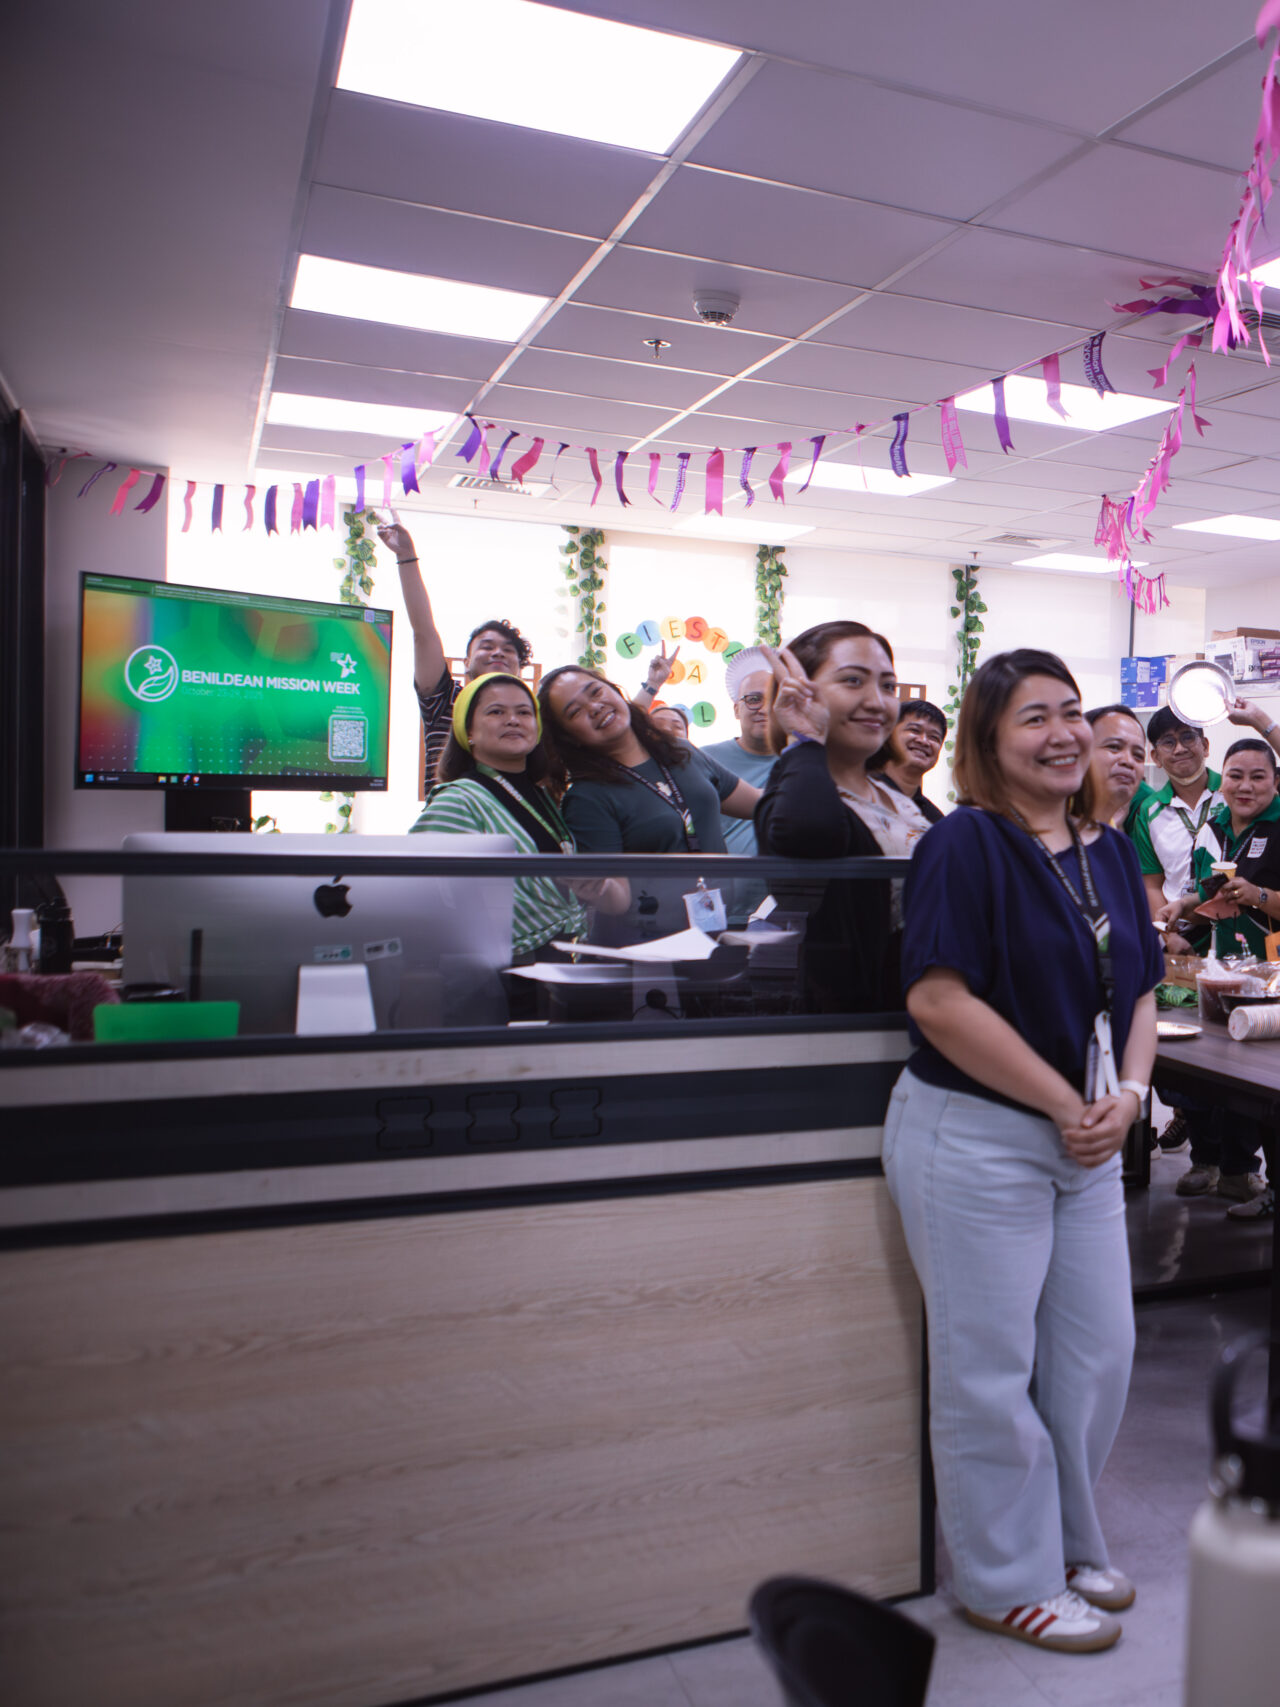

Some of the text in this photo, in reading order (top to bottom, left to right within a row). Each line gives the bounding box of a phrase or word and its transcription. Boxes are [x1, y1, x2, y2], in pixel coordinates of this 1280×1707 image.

[182, 670, 360, 695] BENILDEAN MISSION WEEK
